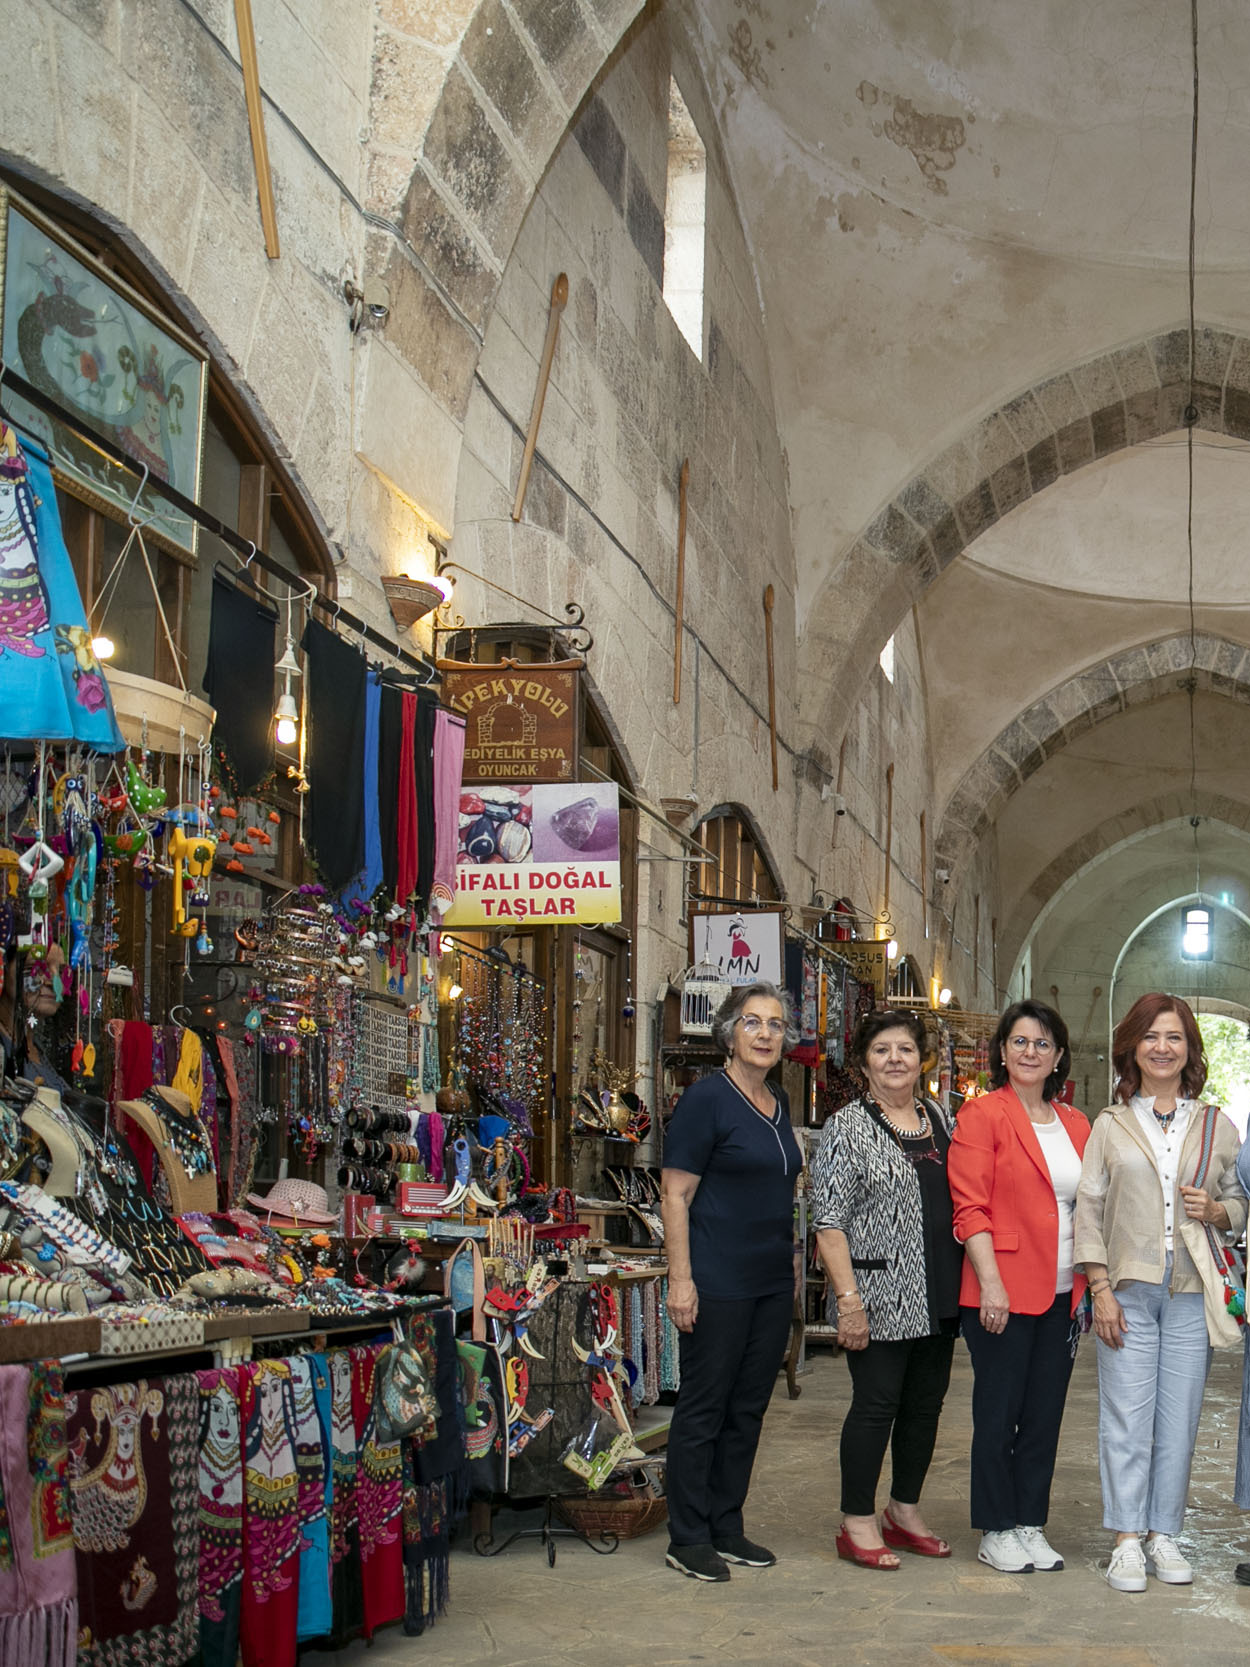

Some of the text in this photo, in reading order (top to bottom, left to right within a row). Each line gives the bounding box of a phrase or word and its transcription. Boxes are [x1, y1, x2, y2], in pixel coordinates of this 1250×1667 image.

[464, 745, 566, 762] EDİYELİK EŞYA
[478, 763, 537, 777] OYUNCAK
[528, 865, 612, 891] DOĞAL
[481, 897, 577, 922] TAŞLAR
